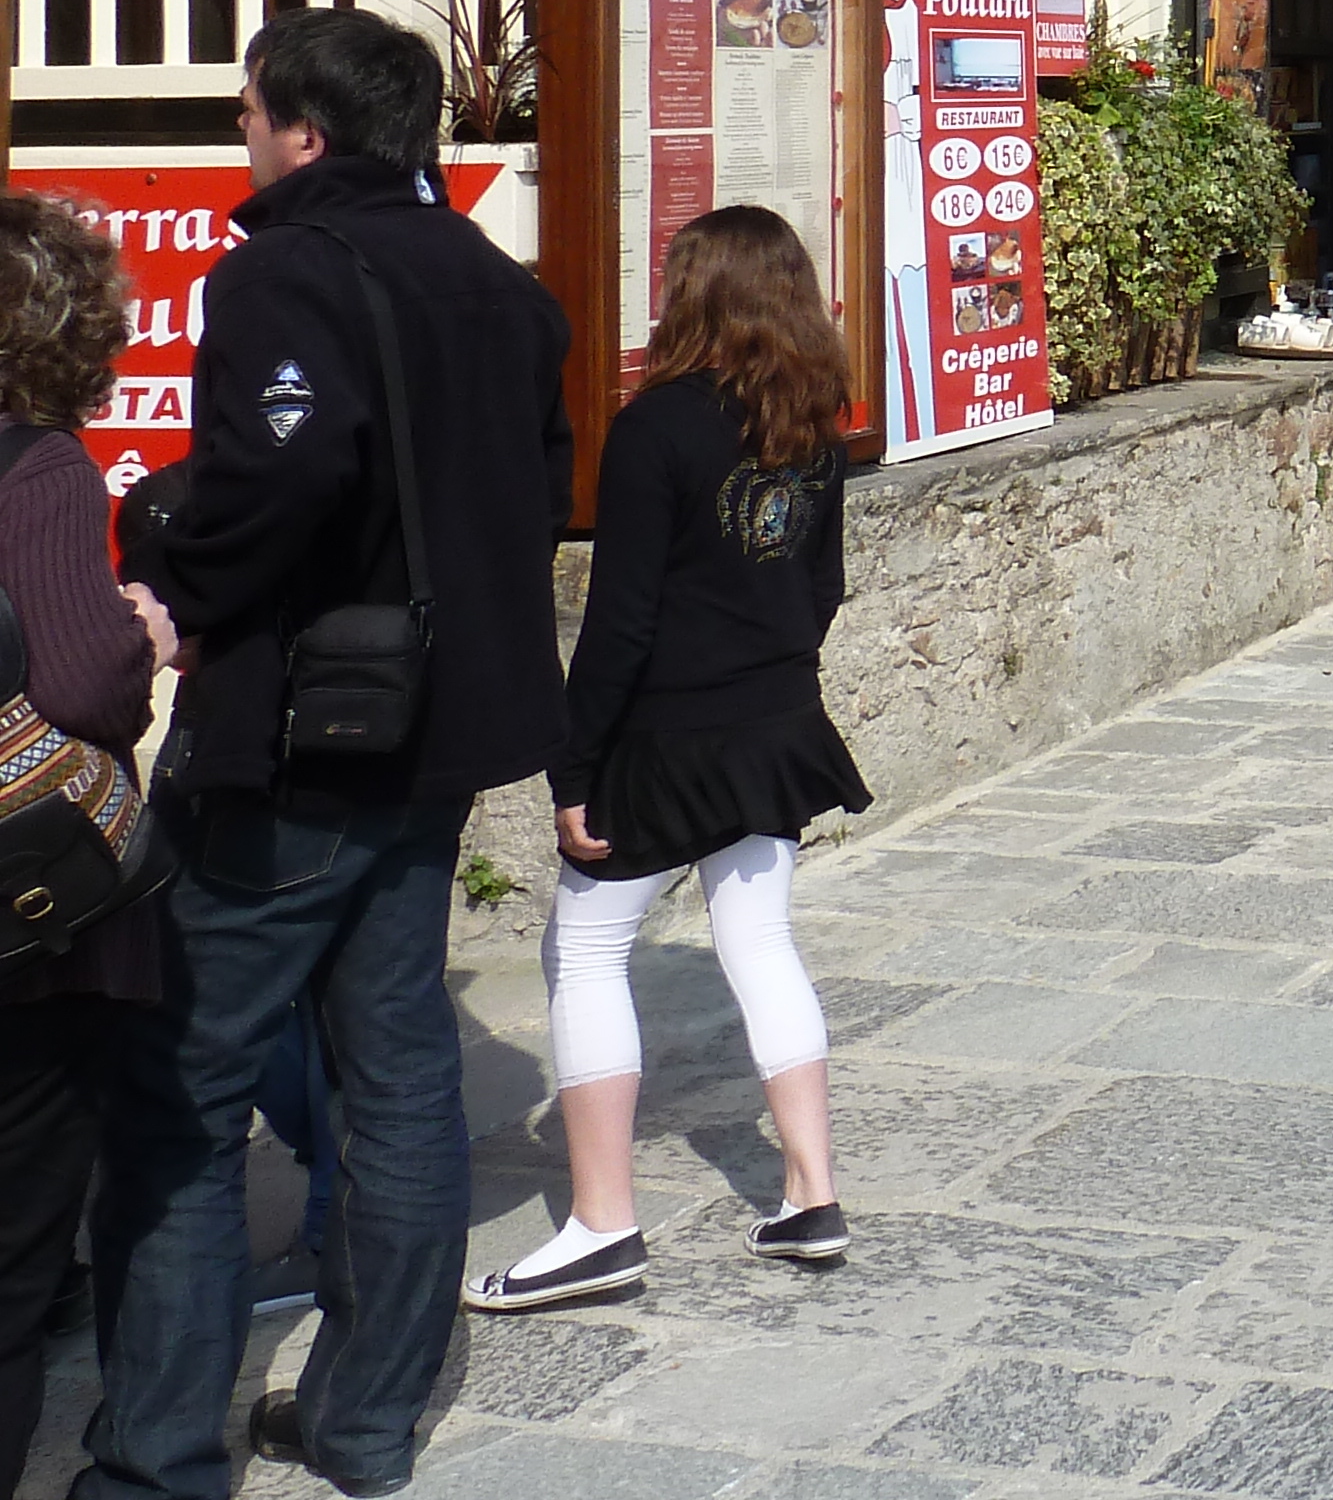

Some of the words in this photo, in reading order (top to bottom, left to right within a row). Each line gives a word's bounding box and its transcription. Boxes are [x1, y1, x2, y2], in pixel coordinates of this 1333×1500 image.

[1036, 21, 1086, 43] CHAMBRES
[941, 111, 1020, 126] RESTAURANT
[944, 146, 968, 171] 6€
[992, 144, 1024, 169] 15€
[940, 193, 975, 220] 18€
[994, 189, 1026, 214] 24€
[942, 336, 1039, 374] Crêperie
[974, 372, 1013, 397] Bar
[965, 393, 1024, 429] Hôtel
